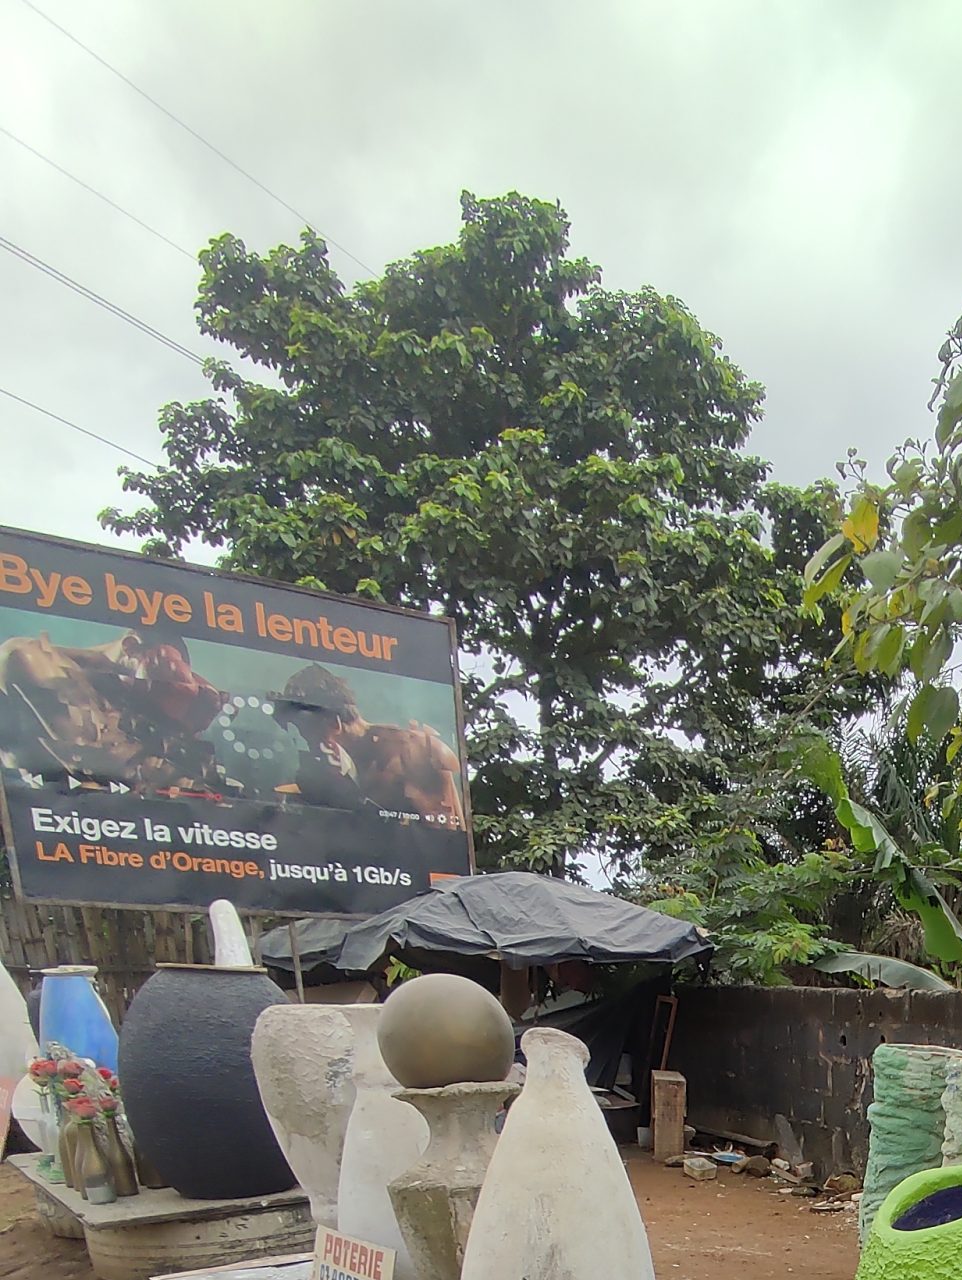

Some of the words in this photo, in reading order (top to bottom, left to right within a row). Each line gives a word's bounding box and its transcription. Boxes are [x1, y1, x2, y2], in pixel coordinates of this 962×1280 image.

[0, 552, 93, 608] Bye
[104, 573, 192, 625] bye
[203, 591, 244, 633] la
[255, 602, 398, 661] lenteur
[31, 807, 138, 841] Exigez
[144, 818, 172, 843] la
[178, 822, 278, 850] vitesse
[36, 841, 74, 863] LA
[79, 844, 143, 867] Fibre
[150, 851, 265, 878] d'Orange,
[269, 860, 348, 883] jusqu'à
[352, 866, 412, 886] 1Gb/s
[324, 1233, 384, 1280] POTERIE
